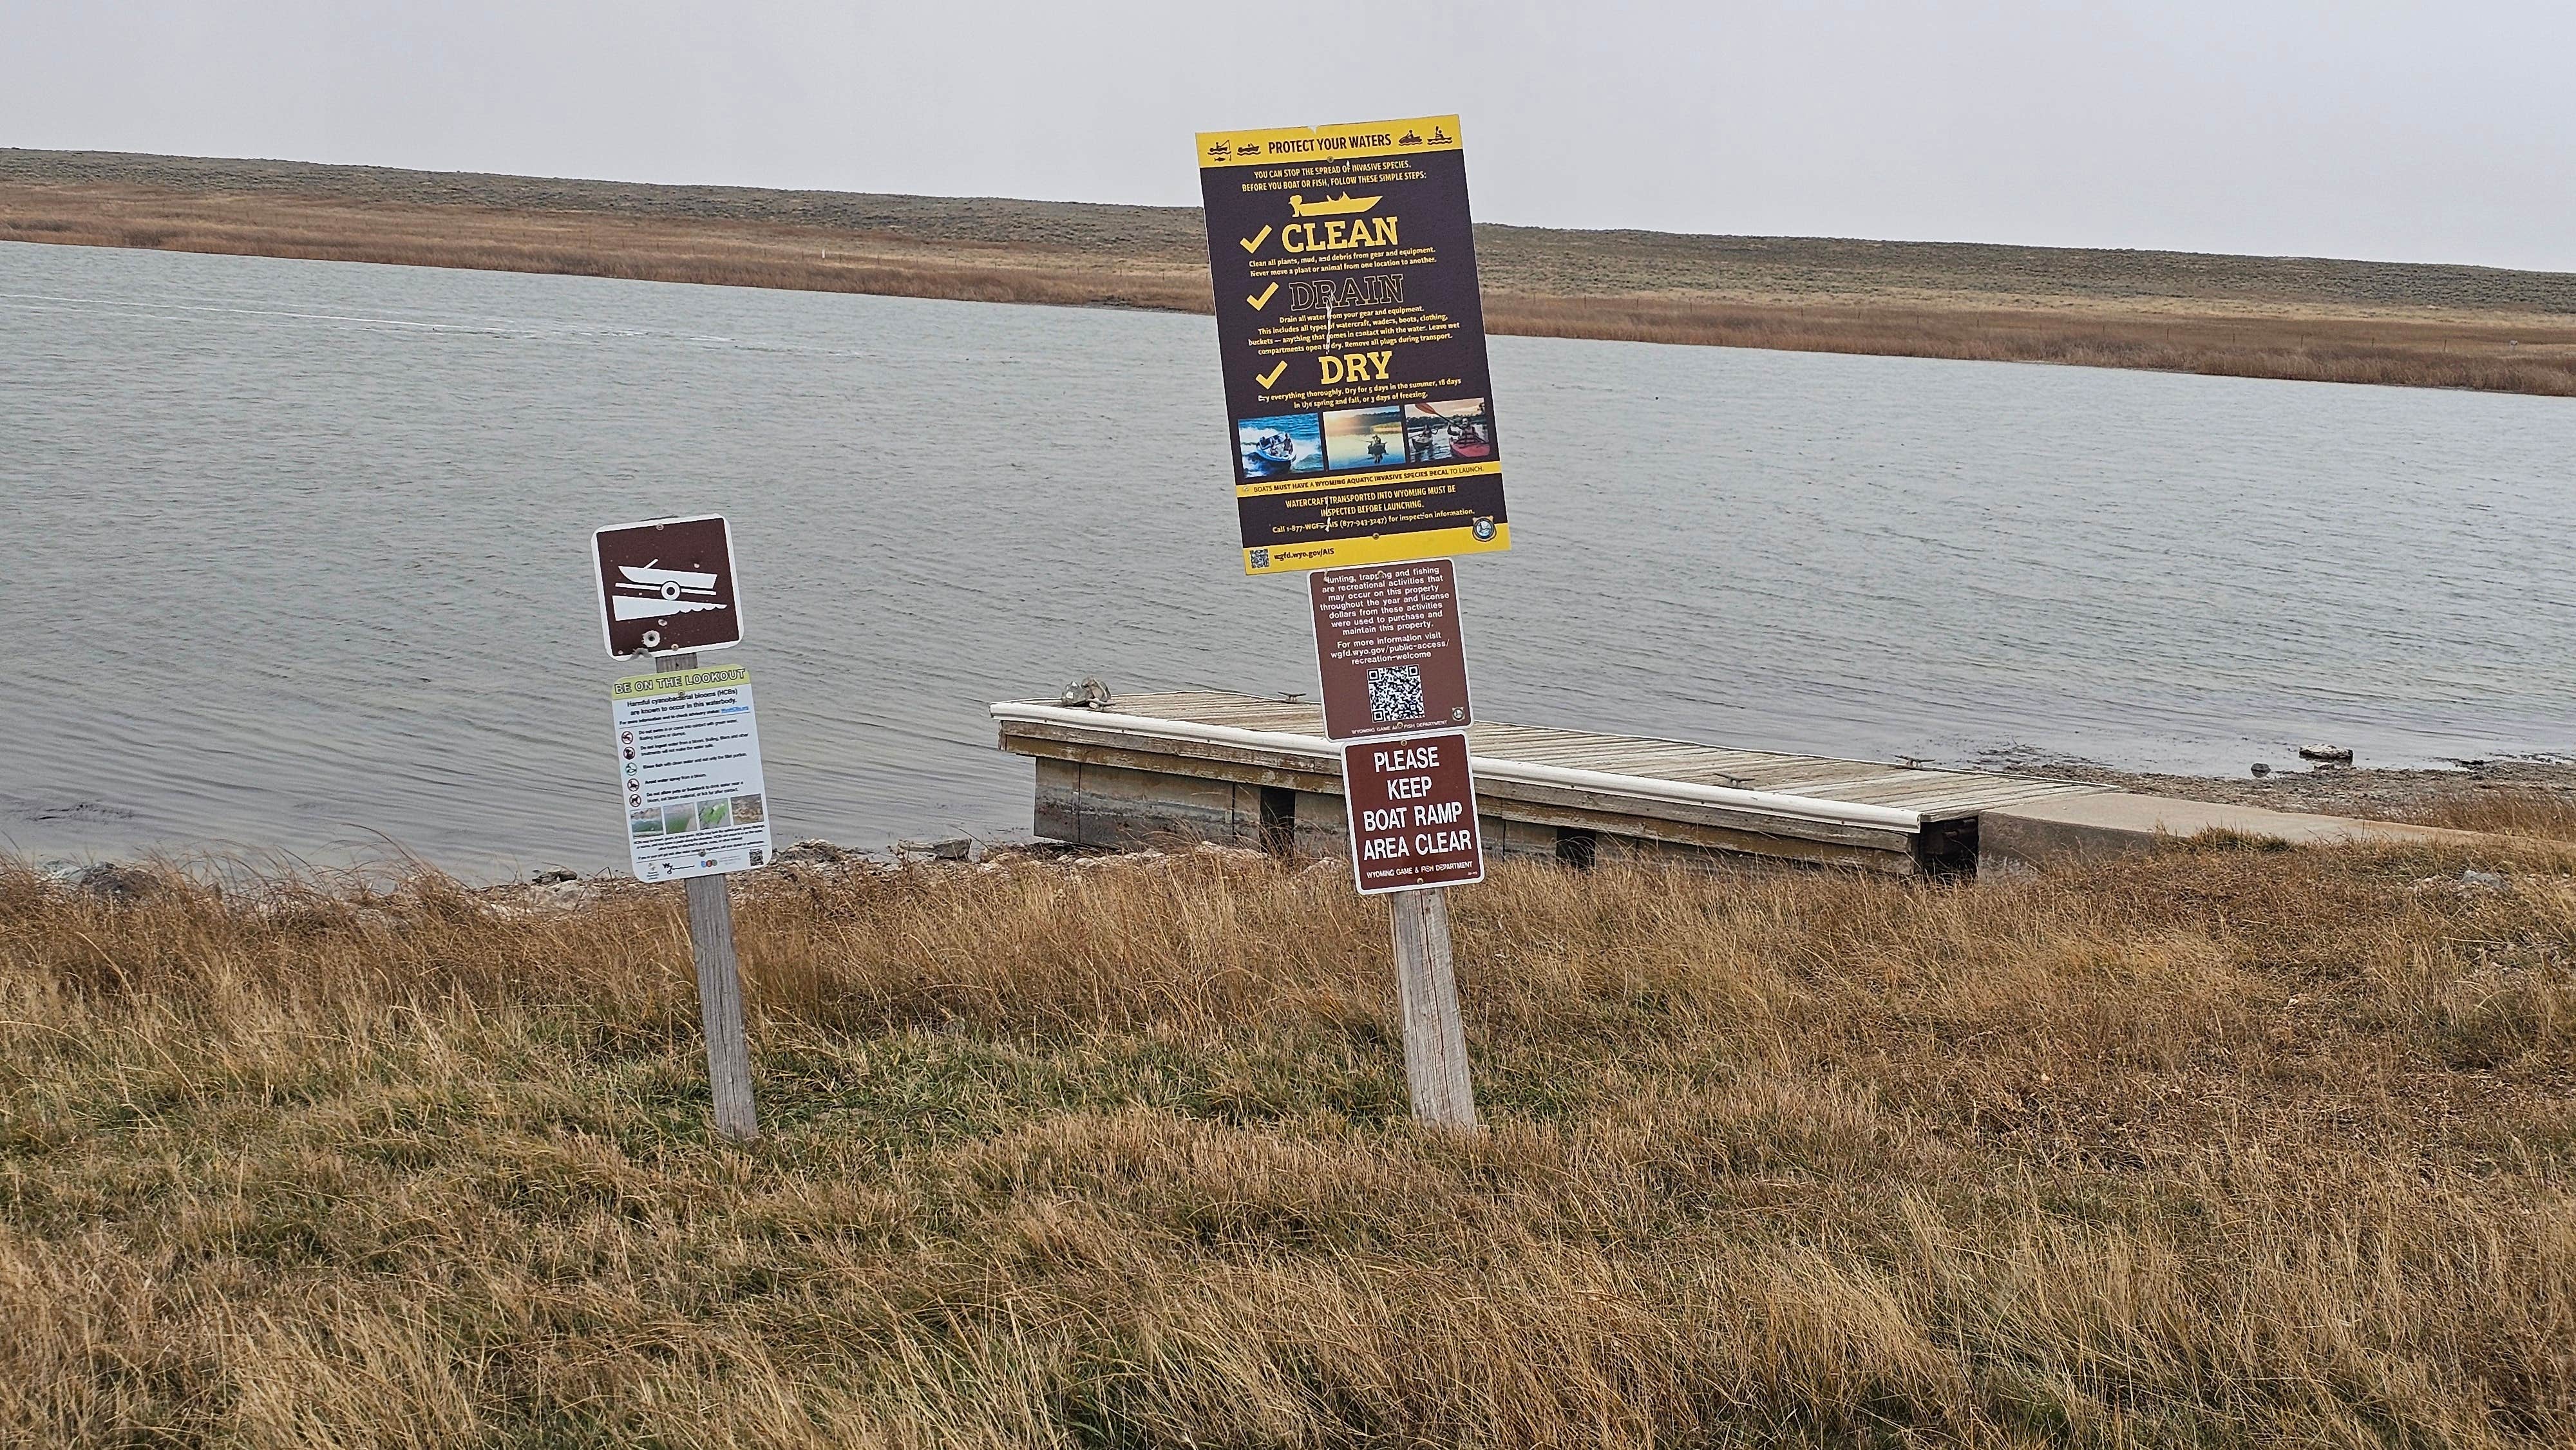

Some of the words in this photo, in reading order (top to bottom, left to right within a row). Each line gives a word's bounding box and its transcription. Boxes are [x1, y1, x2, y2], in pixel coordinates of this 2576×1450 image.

[1268, 138, 1314, 154] PROTECT
[1316, 137, 1349, 151] YOUR
[1348, 133, 1391, 148] WATERS
[1253, 170, 1267, 179] YOU
[1269, 169, 1283, 178] CAN
[1283, 168, 1300, 177] STOP
[1301, 167, 1314, 176] THE
[1351, 162, 1381, 172] INVASIVE
[1242, 182, 1267, 192] BEFORE
[1267, 181, 1282, 190] YOU
[1283, 180, 1300, 189] BOAT
[1312, 178, 1329, 187] FISH,
[1330, 176, 1357, 185] FOLLOW
[1358, 174, 1378, 184] THESE
[1378, 172, 1403, 182] SIMPLE
[1404, 171, 1426, 180] STEPS:
[1282, 216, 1397, 252] CLEAN
[1300, 255, 1317, 263] mud,
[1331, 252, 1352, 261] debris
[1370, 251, 1384, 259] gear
[1399, 247, 1435, 256] equipment.
[1320, 263, 1343, 271] animal
[1374, 259, 1400, 267] location
[1288, 273, 1403, 311] DRAIN
[1272, 325, 1299, 334] includes
[1309, 324, 1329, 332] types
[1419, 313, 1448, 321] clothing,
[1279, 315, 1297, 323] Drain
[1343, 312, 1358, 320] your
[1359, 310, 1374, 319] gear
[1331, 342, 1343, 350] dry.
[1379, 337, 1397, 346] plugs
[1397, 335, 1419, 343] during
[1318, 350, 1392, 384] DRY
[1271, 391, 1305, 401] everything
[1306, 388, 1343, 397] thoroughly.
[1345, 387, 1356, 395] Dry
[1313, 399, 1334, 408] spring
[1347, 476, 1374, 484] AQUATIC
[1328, 492, 1376, 504] TRANSPORTED
[1376, 491, 1392, 500] INTO
[1393, 487, 1426, 498] WYOMING
[1427, 485, 1446, 494] MUST
[1446, 484, 1456, 493] BE
[1357, 504, 1383, 513] BEFORE
[1395, 569, 1410, 577] and
[1412, 566, 1439, 575] fishing
[1338, 579, 1385, 592] recreational
[1388, 576, 1425, 587] activities
[1427, 574, 1443, 583] that
[1387, 587, 1401, 596] this
[1405, 584, 1439, 595] property
[1320, 599, 1363, 611] throughout
[1382, 598, 1400, 606] year
[1403, 594, 1418, 603] and
[1421, 592, 1449, 601] license
[1329, 610, 1356, 619] dollars
[1406, 601, 1443, 611] activities
[1354, 616, 1374, 625] used
[1388, 612, 1425, 623] purchase
[1427, 609, 1443, 617] and
[1342, 625, 1376, 636] maintain
[1379, 623, 1394, 632] this
[1397, 620, 1434, 631] property.
[1376, 634, 1422, 645] information
[1425, 631, 1441, 639] visit
[613, 682, 632, 694] BE
[634, 679, 654, 692] ON
[655, 675, 683, 689] THE
[684, 667, 746, 686] LOOKOUT
[1374, 746, 1439, 773] PLEASE
[1387, 776, 1432, 800] KEEP
[1363, 807, 1407, 831] BOAT
[1414, 801, 1462, 826] RAMP
[1363, 836, 1410, 860] AREA
[1415, 829, 1472, 855] CLEAR
[1366, 869, 1394, 878] WYOMING
[1396, 867, 1413, 875] GAME
